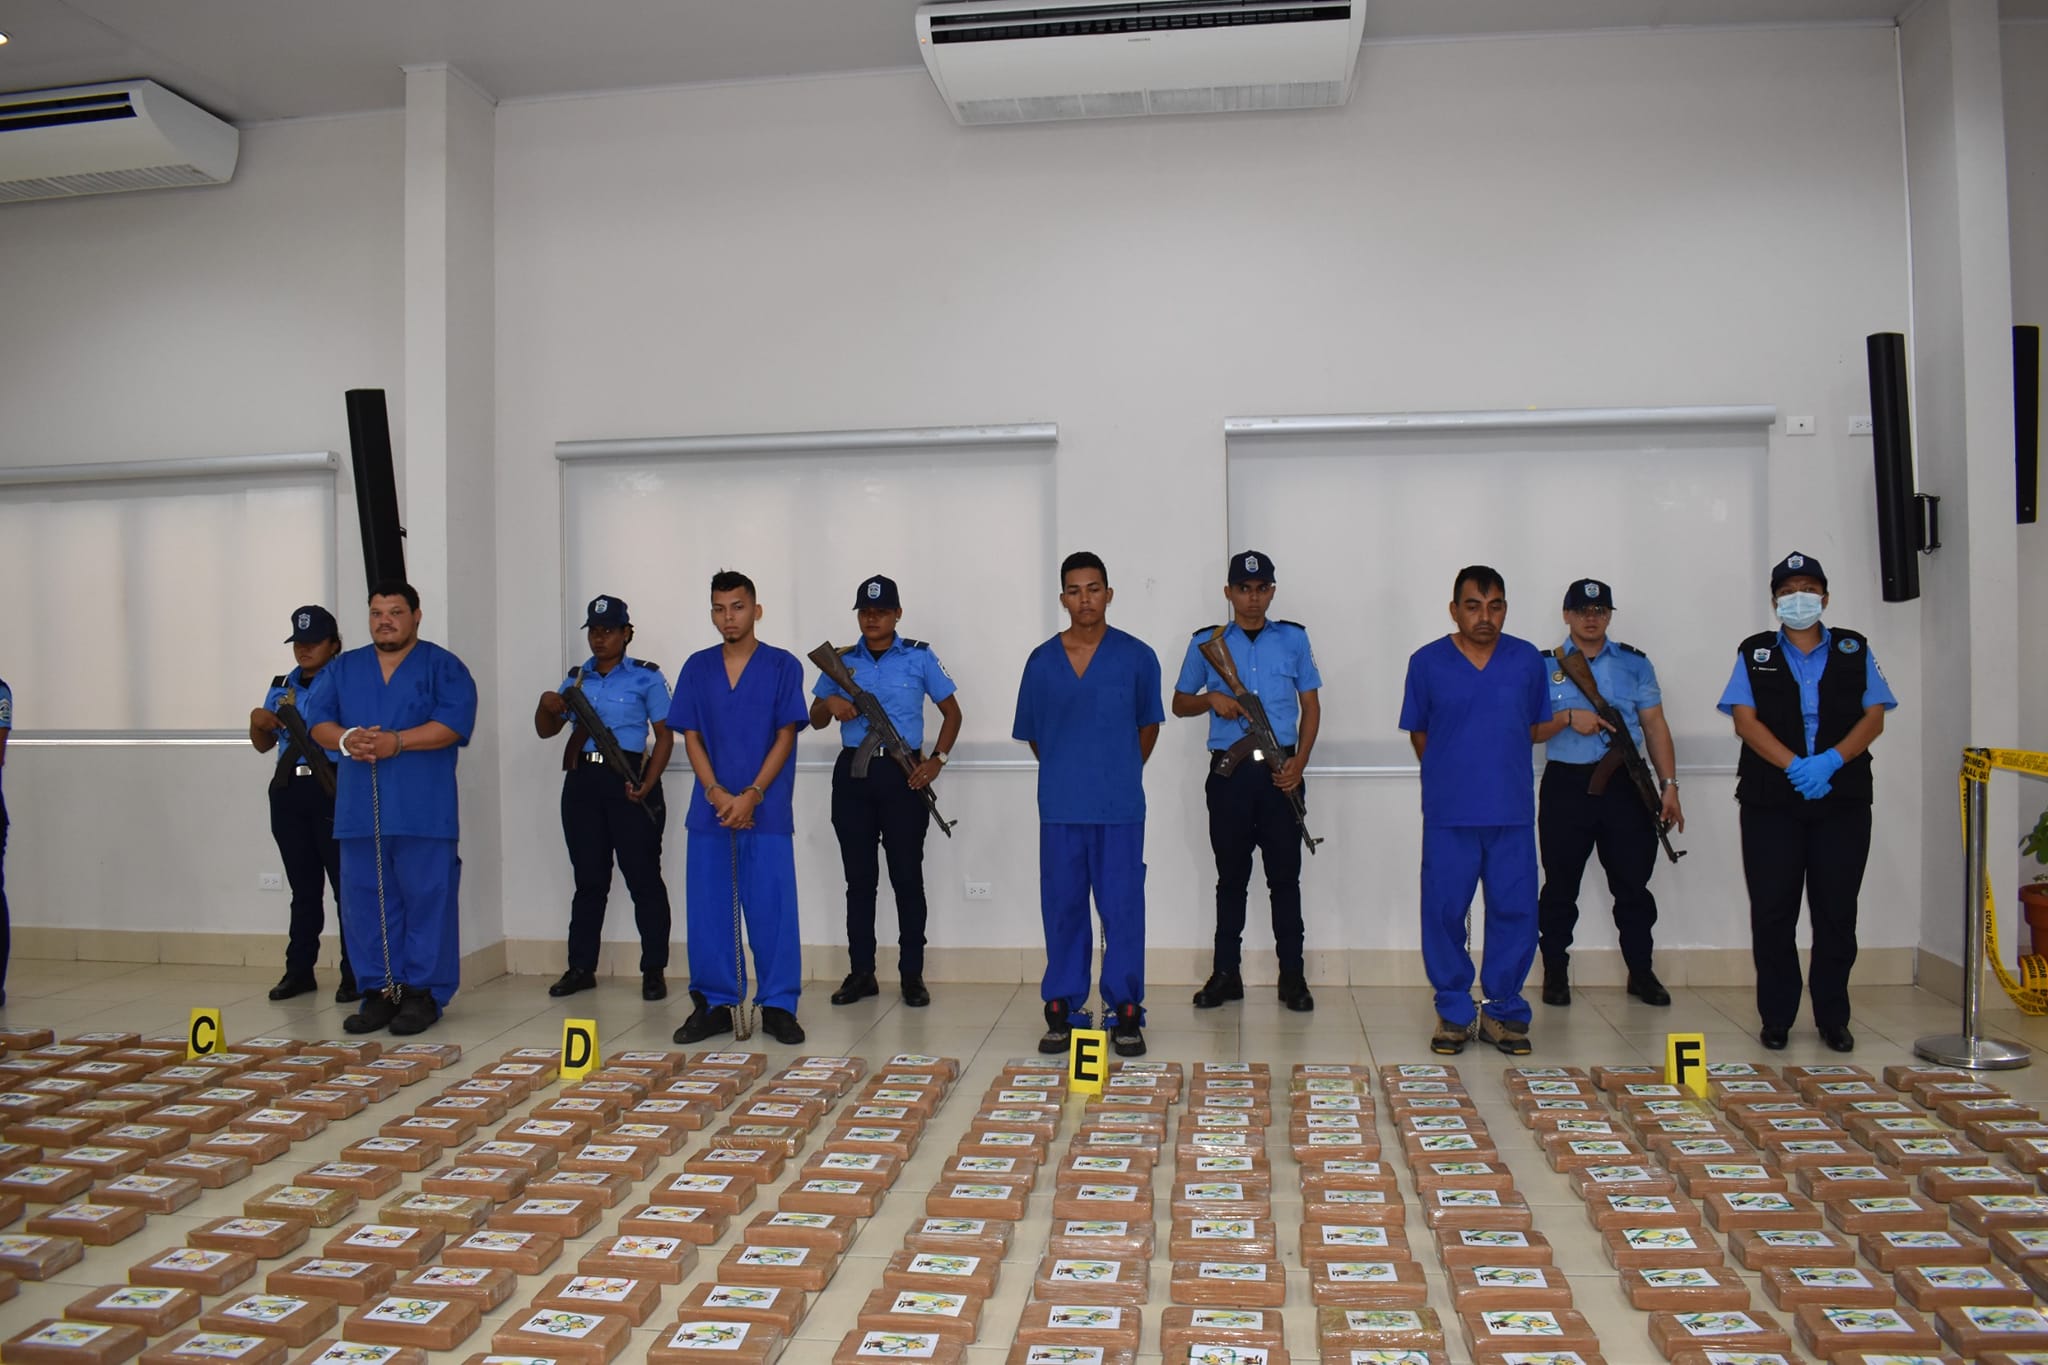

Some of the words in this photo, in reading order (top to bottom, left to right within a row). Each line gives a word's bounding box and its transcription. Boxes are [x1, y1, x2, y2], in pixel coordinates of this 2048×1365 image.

[192, 1016, 215, 1054] C
[565, 1027, 592, 1068] D
[1074, 1038, 1100, 1082] E
[1675, 1041, 1701, 1084] F
